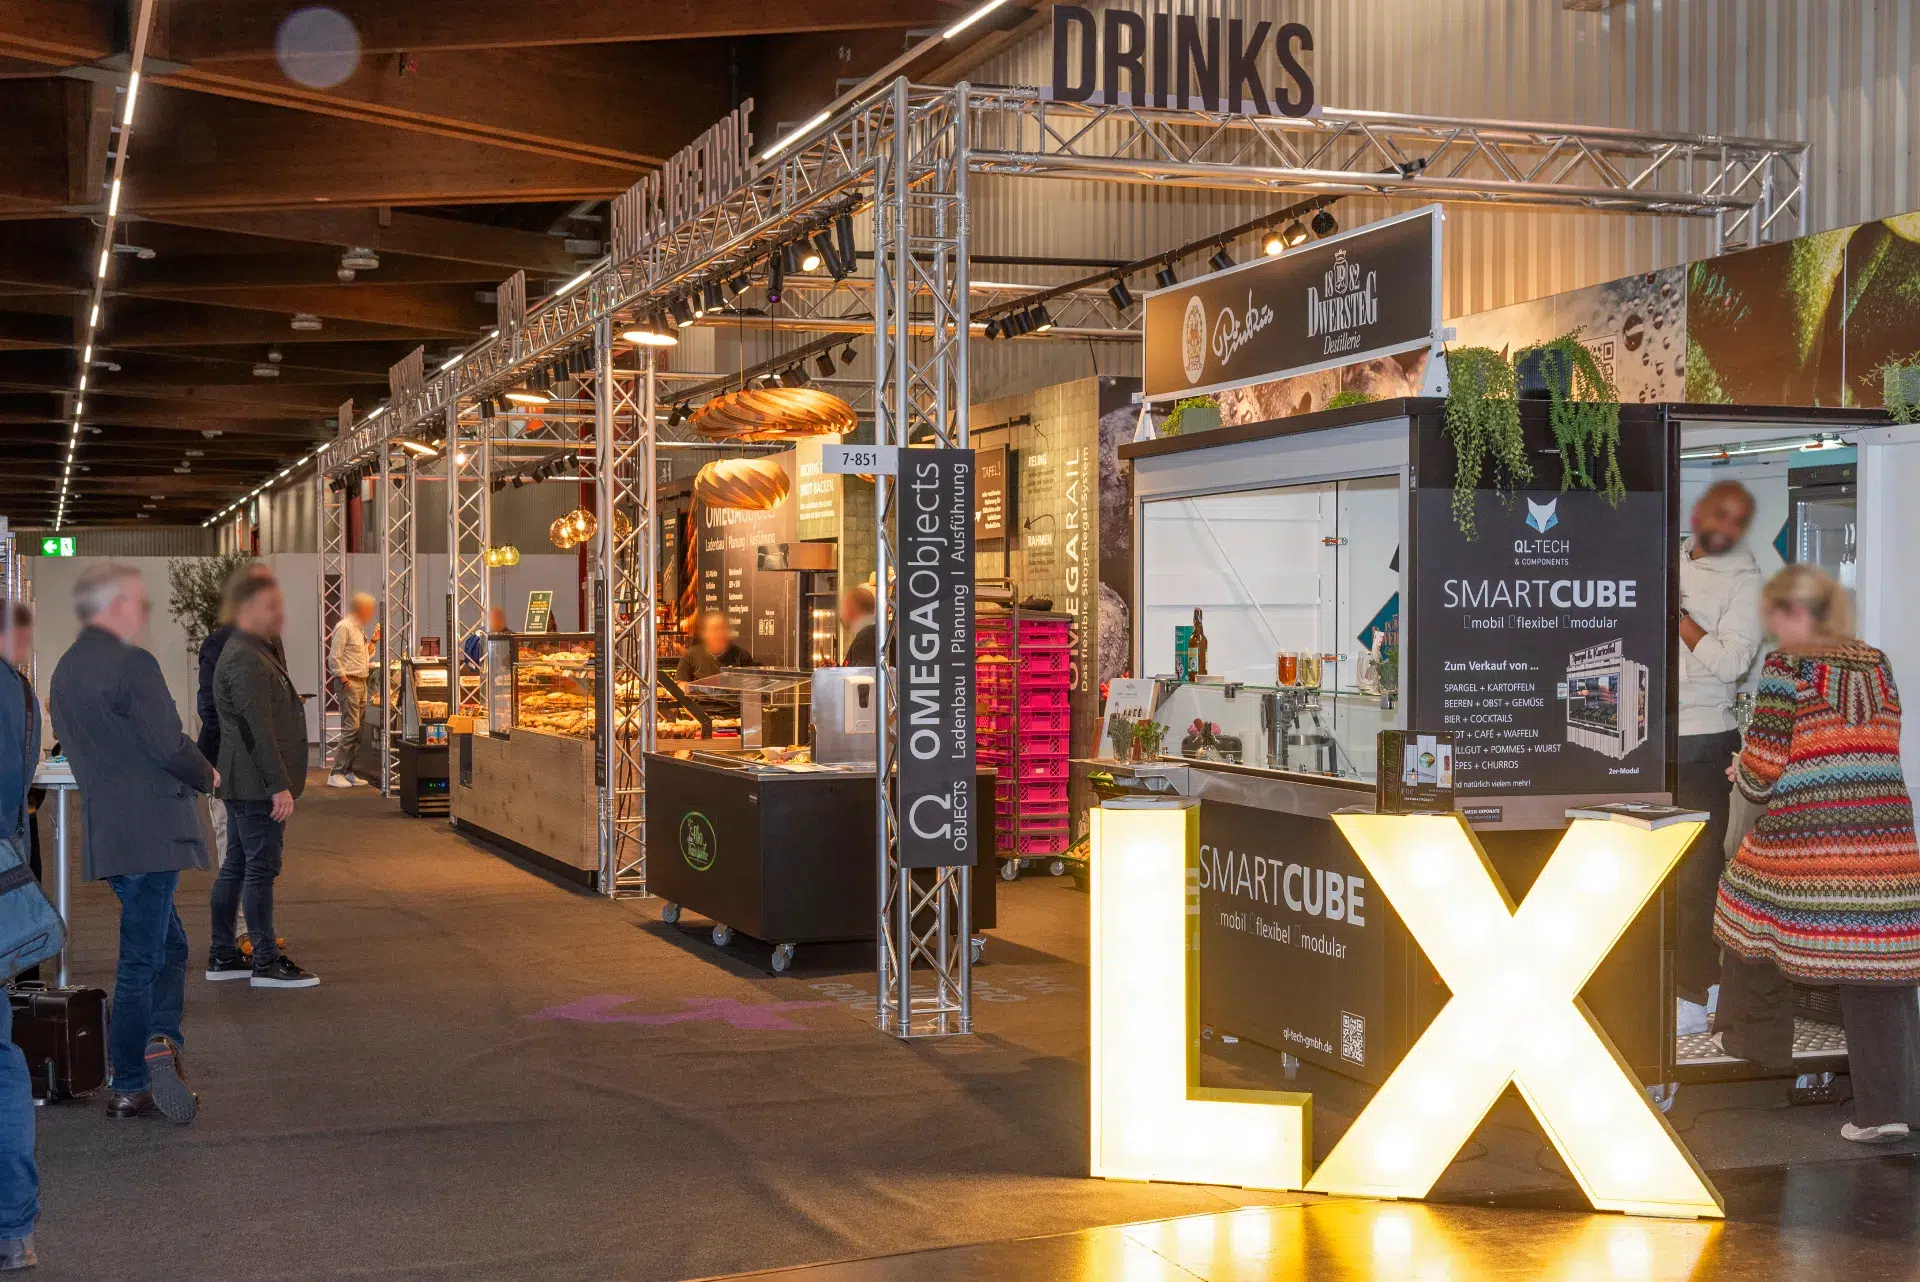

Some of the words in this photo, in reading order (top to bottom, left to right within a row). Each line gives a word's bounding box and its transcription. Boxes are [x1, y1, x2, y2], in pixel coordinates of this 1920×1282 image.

[1052, 5, 1315, 118] DRINKS
[611, 176, 648, 267] FRUIT
[649, 169, 664, 242] &
[663, 97, 758, 233] VEGETABLE
[1323, 331, 1361, 355] Destillerie
[842, 452, 878, 466] 7-851
[950, 463, 969, 563] Ausführung
[1081, 447, 1090, 596] Shop-Regal-System
[705, 537, 725, 552] Ladenbau
[728, 535, 746, 551] Planung
[1027, 534, 1052, 547] RAHMEN
[1514, 539, 1570, 553] QL-TECH
[1514, 558, 1520, 566] &
[1521, 558, 1569, 566] COMPONENTS
[1443, 579, 1637, 608] SMARTCUBE
[908, 462, 948, 761] OMEGAObjects
[951, 584, 969, 653] Planung
[1081, 601, 1089, 659] flexible
[1471, 616, 1504, 629] mobil
[1516, 616, 1558, 629] flexibel
[1570, 616, 1618, 629] modular
[1444, 661, 1466, 671] Zum
[1469, 660, 1508, 671] Verkauf
[1509, 662, 1528, 671] von
[1081, 664, 1089, 692] Das
[1444, 683, 1478, 692] SPARGEL
[1487, 682, 1535, 692] KARTOFFELN
[1444, 699, 1473, 708] BEEREN
[1482, 698, 1503, 708] OBST
[1511, 697, 1545, 707] GEMÜSE
[951, 674, 967, 760] Ladenbau
[1444, 714, 1461, 724] BIER
[1470, 713, 1513, 723] COCKTAILS
[1474, 728, 1494, 739] CAFÉ
[1503, 729, 1539, 738] WAFFELN
[1490, 744, 1525, 754] POMMES
[1534, 743, 1562, 753] WURST
[1481, 760, 1519, 770] CHURROS
[1608, 767, 1640, 775] 2er-Modul
[1464, 780, 1491, 789] natürlich
[1491, 779, 1512, 788] vielem
[1512, 779, 1531, 788] mehr!
[953, 780, 968, 851] OBJECTS
[1200, 844, 1365, 927] SMARTCUBE
[1220, 910, 1246, 932] mobil
[1255, 916, 1291, 945] flexibel
[1301, 932, 1347, 960] modular
[1283, 1027, 1333, 1054] ql-tech-gmbh.de
